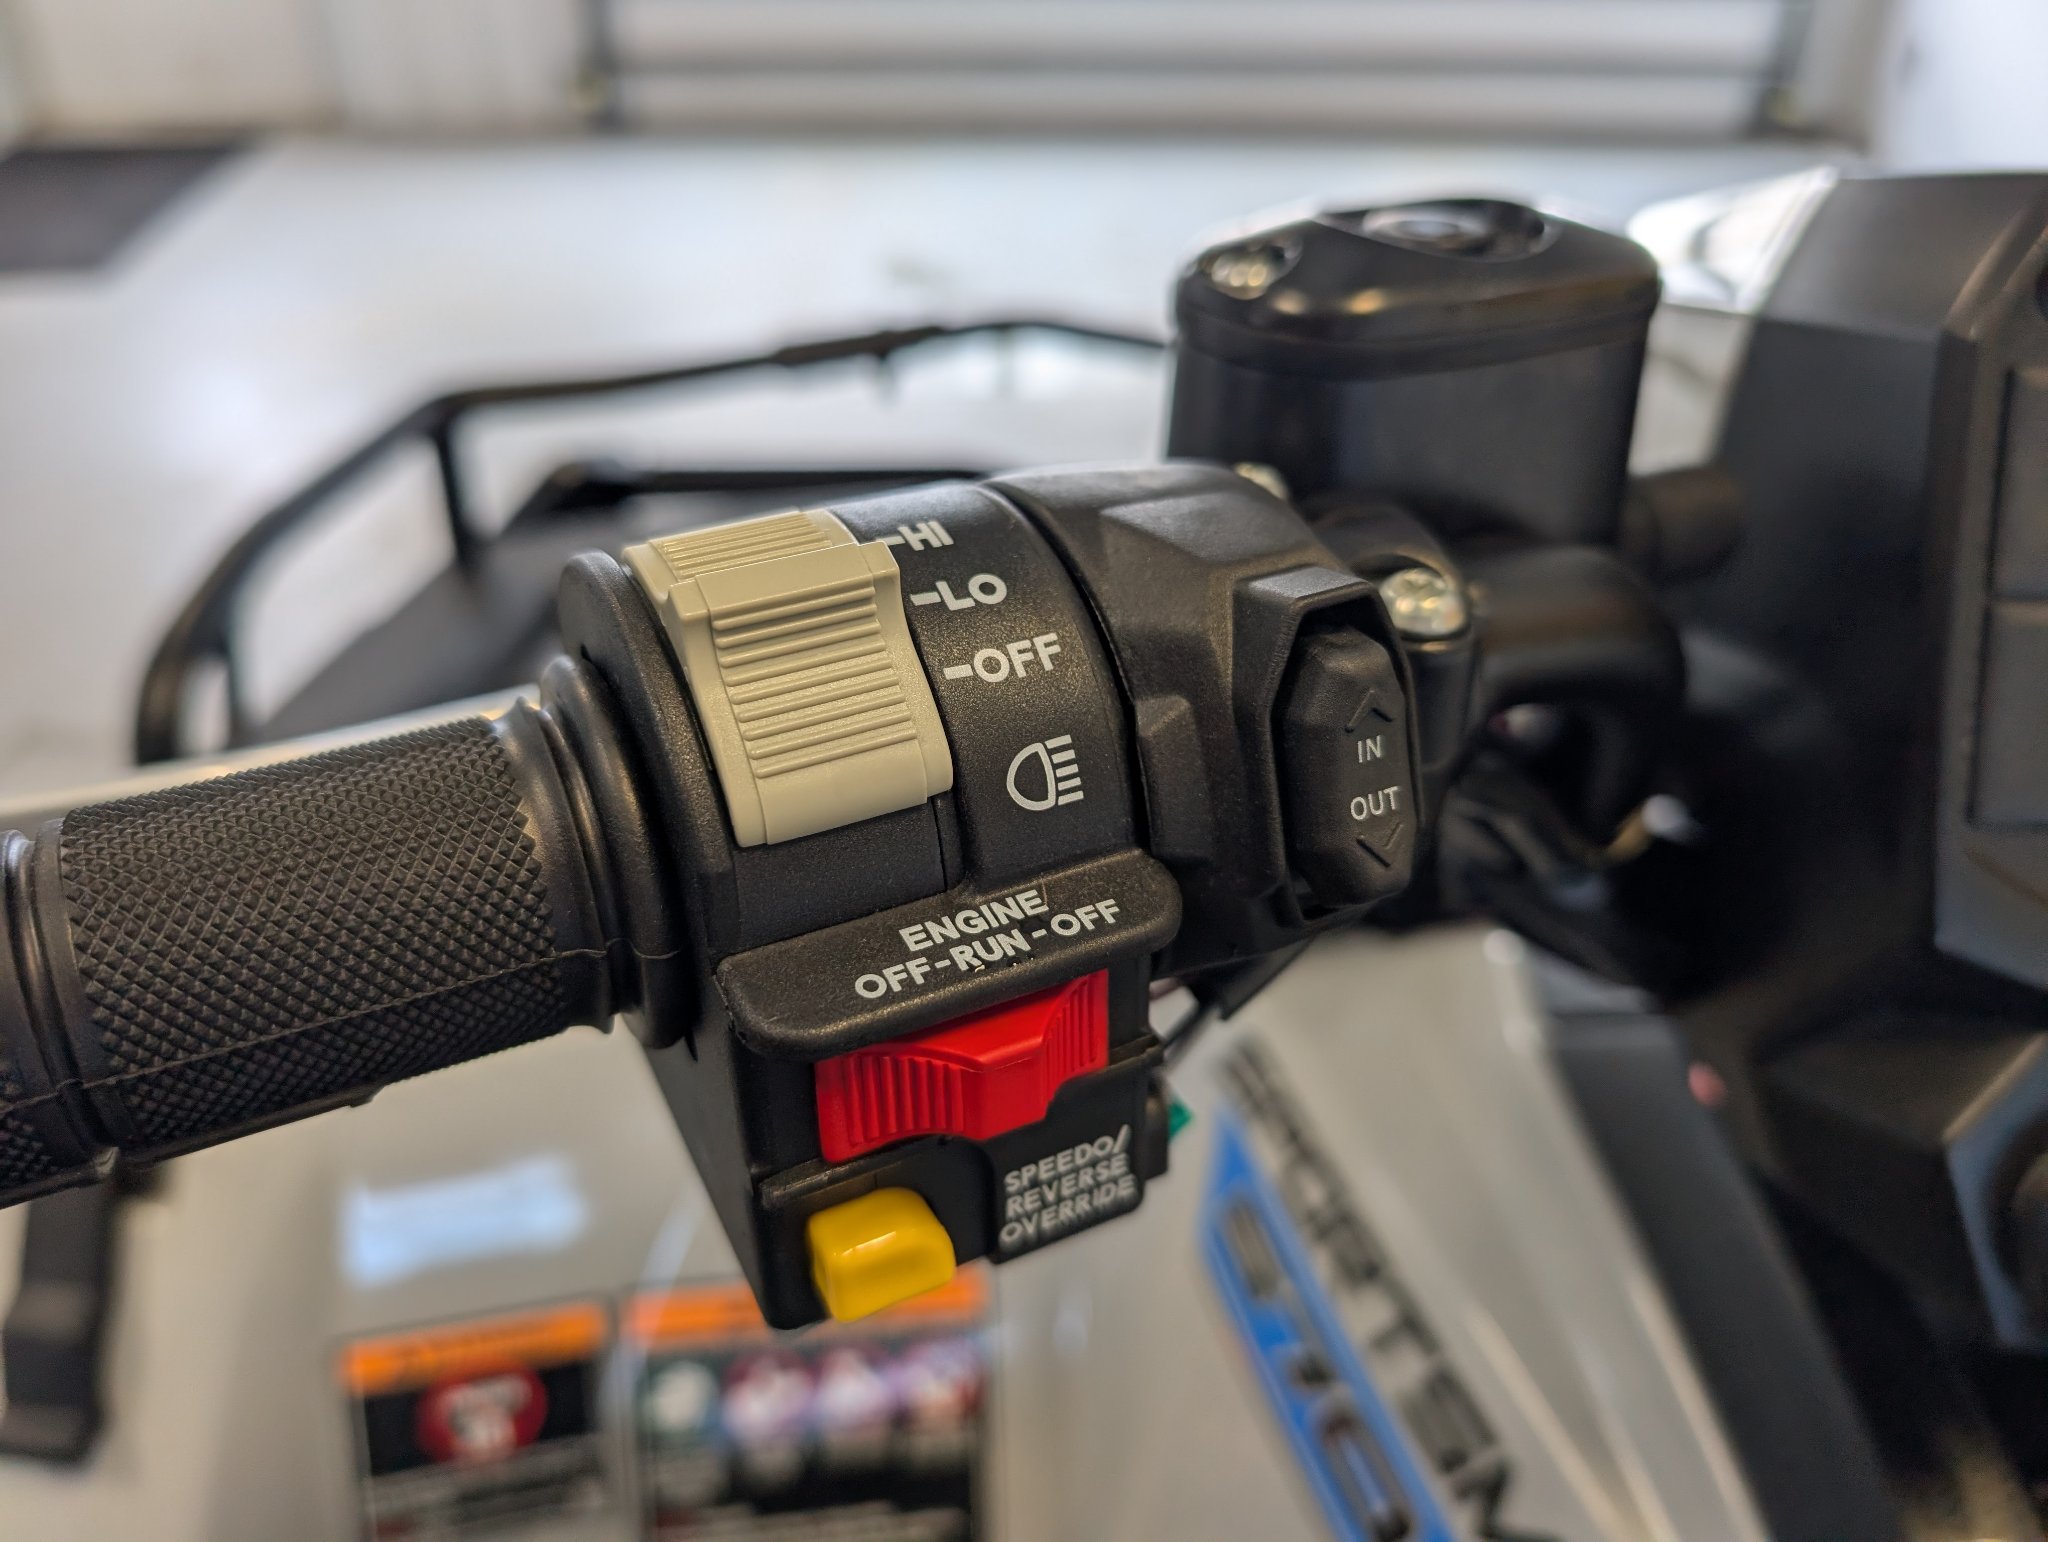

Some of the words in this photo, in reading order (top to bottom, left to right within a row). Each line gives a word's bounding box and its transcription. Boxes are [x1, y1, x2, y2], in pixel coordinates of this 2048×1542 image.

[1357, 735, 1382, 764] IN
[1350, 785, 1401, 821] OUT
[898, 889, 1050, 952] ENGINE
[1004, 1124, 1131, 1193] SPEEDO/
[1006, 1152, 1130, 1221] REVERSE
[999, 1174, 1137, 1246] OVERRIDE
